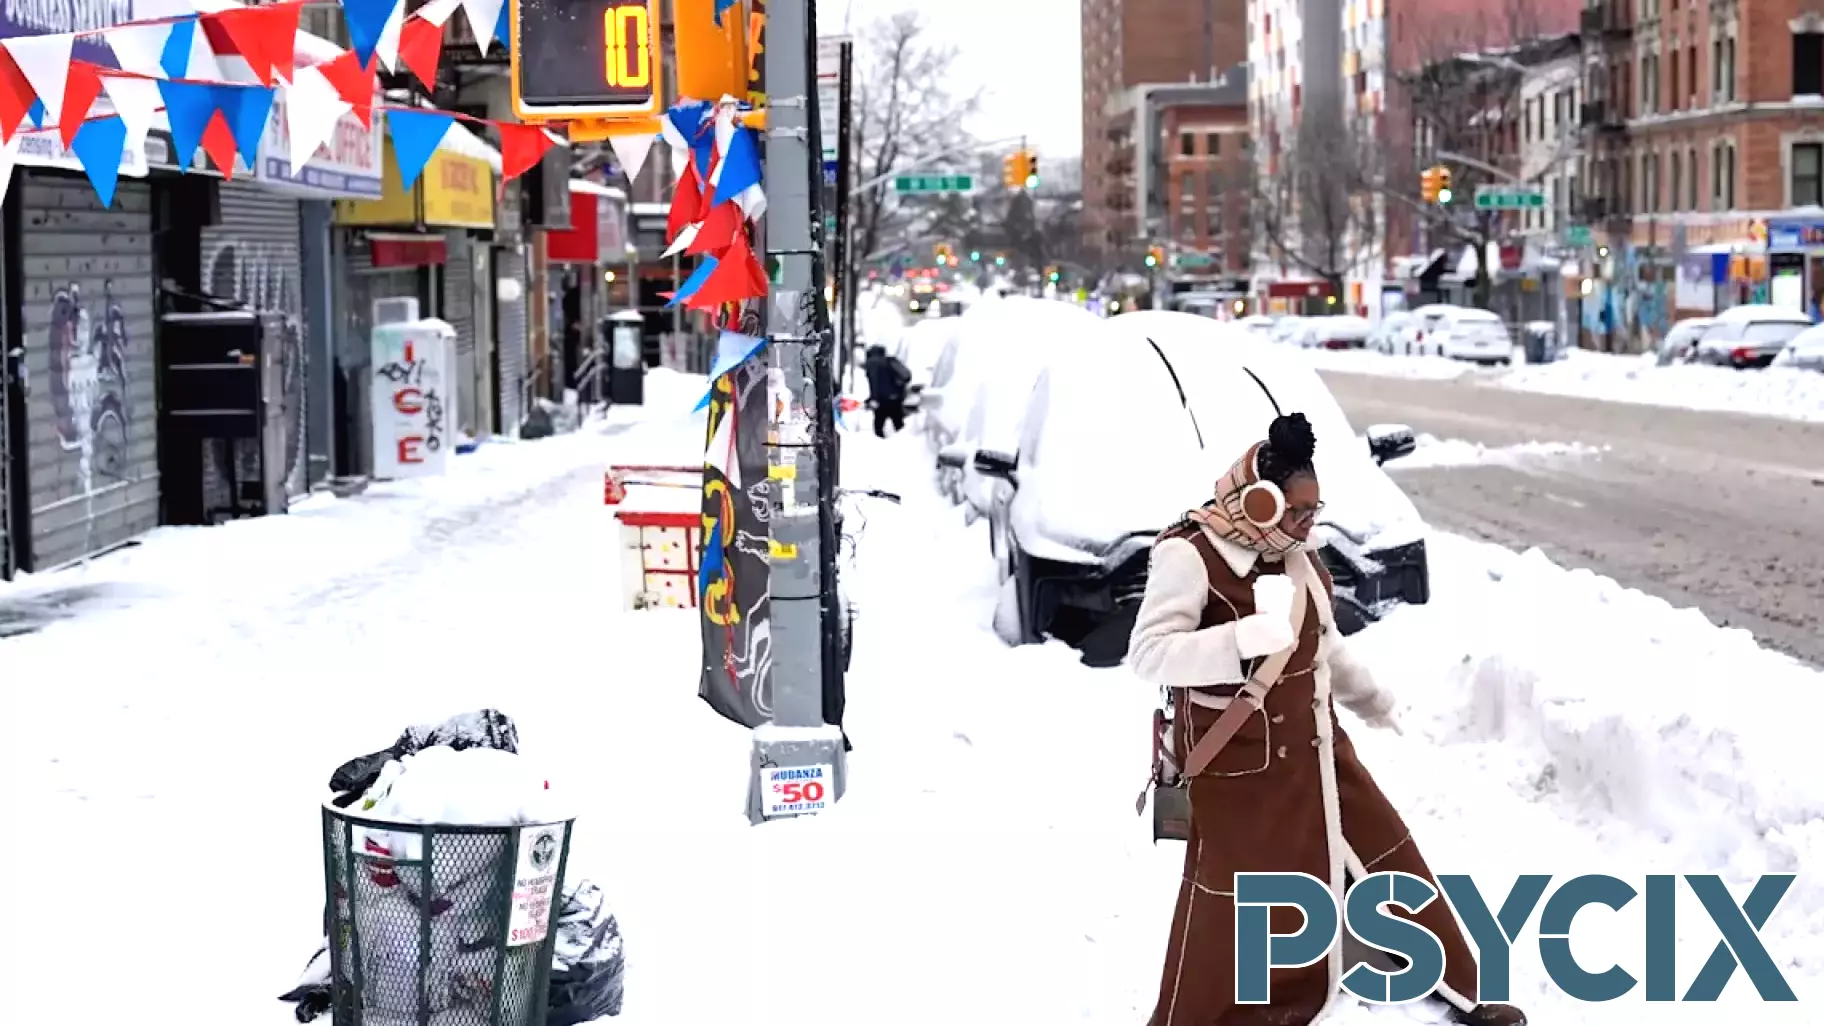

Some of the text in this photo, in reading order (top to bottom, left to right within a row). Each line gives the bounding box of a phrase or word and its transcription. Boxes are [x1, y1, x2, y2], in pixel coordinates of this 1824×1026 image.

[604, 5, 649, 87] 10
[771, 768, 822, 780] MUDANZA
[772, 781, 824, 803] $50
